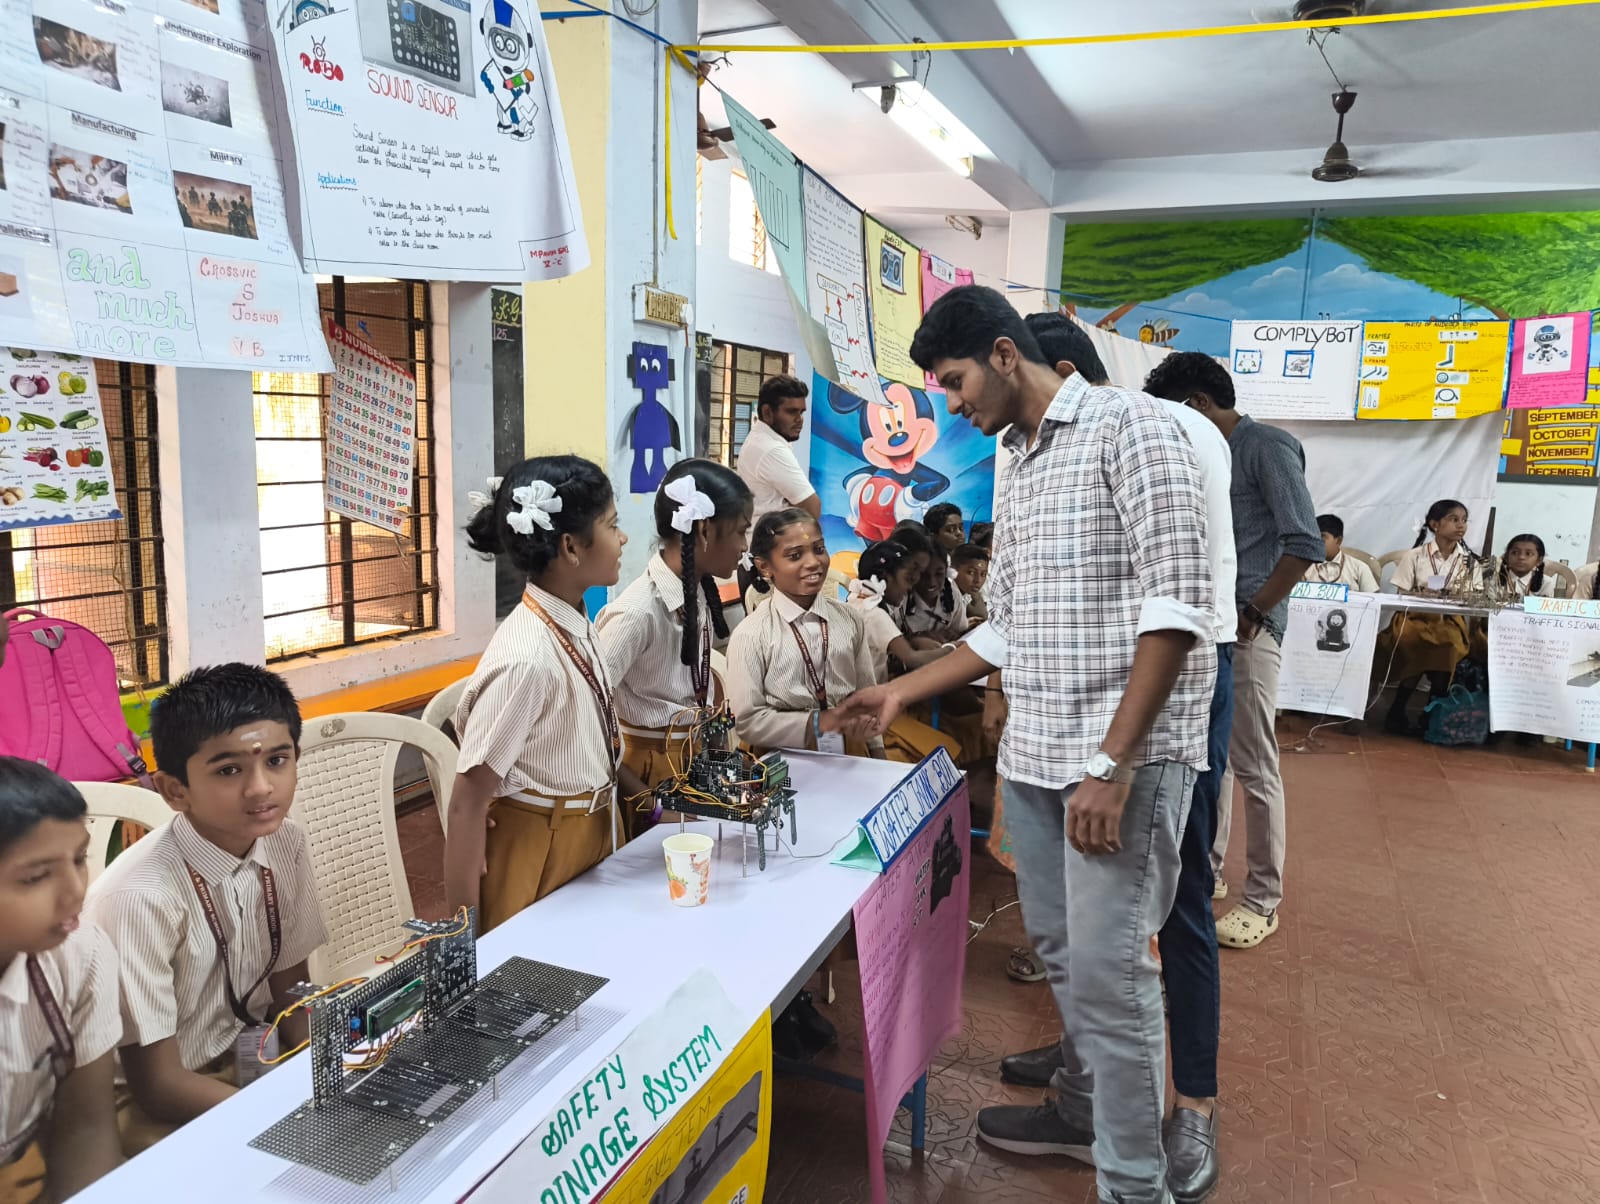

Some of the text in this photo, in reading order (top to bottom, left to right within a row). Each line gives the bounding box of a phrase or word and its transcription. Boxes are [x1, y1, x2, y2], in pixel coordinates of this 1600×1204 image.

[164, 21, 262, 61] Underwater Exploration
[304, 89, 344, 114] Function
[367, 69, 459, 120] SOUND SENSOR
[71, 112, 137, 140] Manufacturing
[353, 123, 373, 141] Sound
[466, 151, 484, 160] which
[209, 150, 243, 165] Military
[66, 246, 151, 289] and
[242, 284, 254, 300] S
[94, 290, 194, 330] much
[75, 321, 177, 357] more
[253, 342, 265, 357] B
[345, 331, 391, 365] NUMBERS
[339, 364, 412, 405] 12 13 14 15 16 17 20
[367, 362, 371, 370] 5
[406, 382, 413, 391] 10
[338, 381, 412, 420] 22 23 24 25 26 30
[345, 401, 411, 435] 33 34 35 37 39 40
[1530, 410, 1598, 422] SEPTEMBER
[336, 429, 409, 465] 52 57 58 59 60
[352, 422, 410, 451] 44 45 47 49 50
[1533, 429, 1591, 440] OCTOBER
[336, 446, 408, 480] 62 67 68 69 70
[1528, 448, 1589, 458] NOVEMBER
[335, 463, 407, 495] 72 73 74 75 77 78 79 80
[1528, 468, 1590, 477] DECEMBER
[342, 499, 356, 511] 93 94
[387, 500, 395, 508] 89
[1537, 599, 1587, 614] TRAFFIC
[1522, 616, 1600, 630] TRAFFIC SIGNAL
[572, 651, 589, 678] PRIMARY
[872, 789, 918, 858] WATER
[906, 768, 938, 817] TANK
[932, 752, 956, 794] BOT
[198, 883, 214, 912] PRIMARY
[264, 876, 274, 905] PRIMARY
[269, 907, 278, 932] SCHOOL
[642, 1024, 722, 1121] SYSTEM
[541, 1054, 626, 1157] SAFETY
